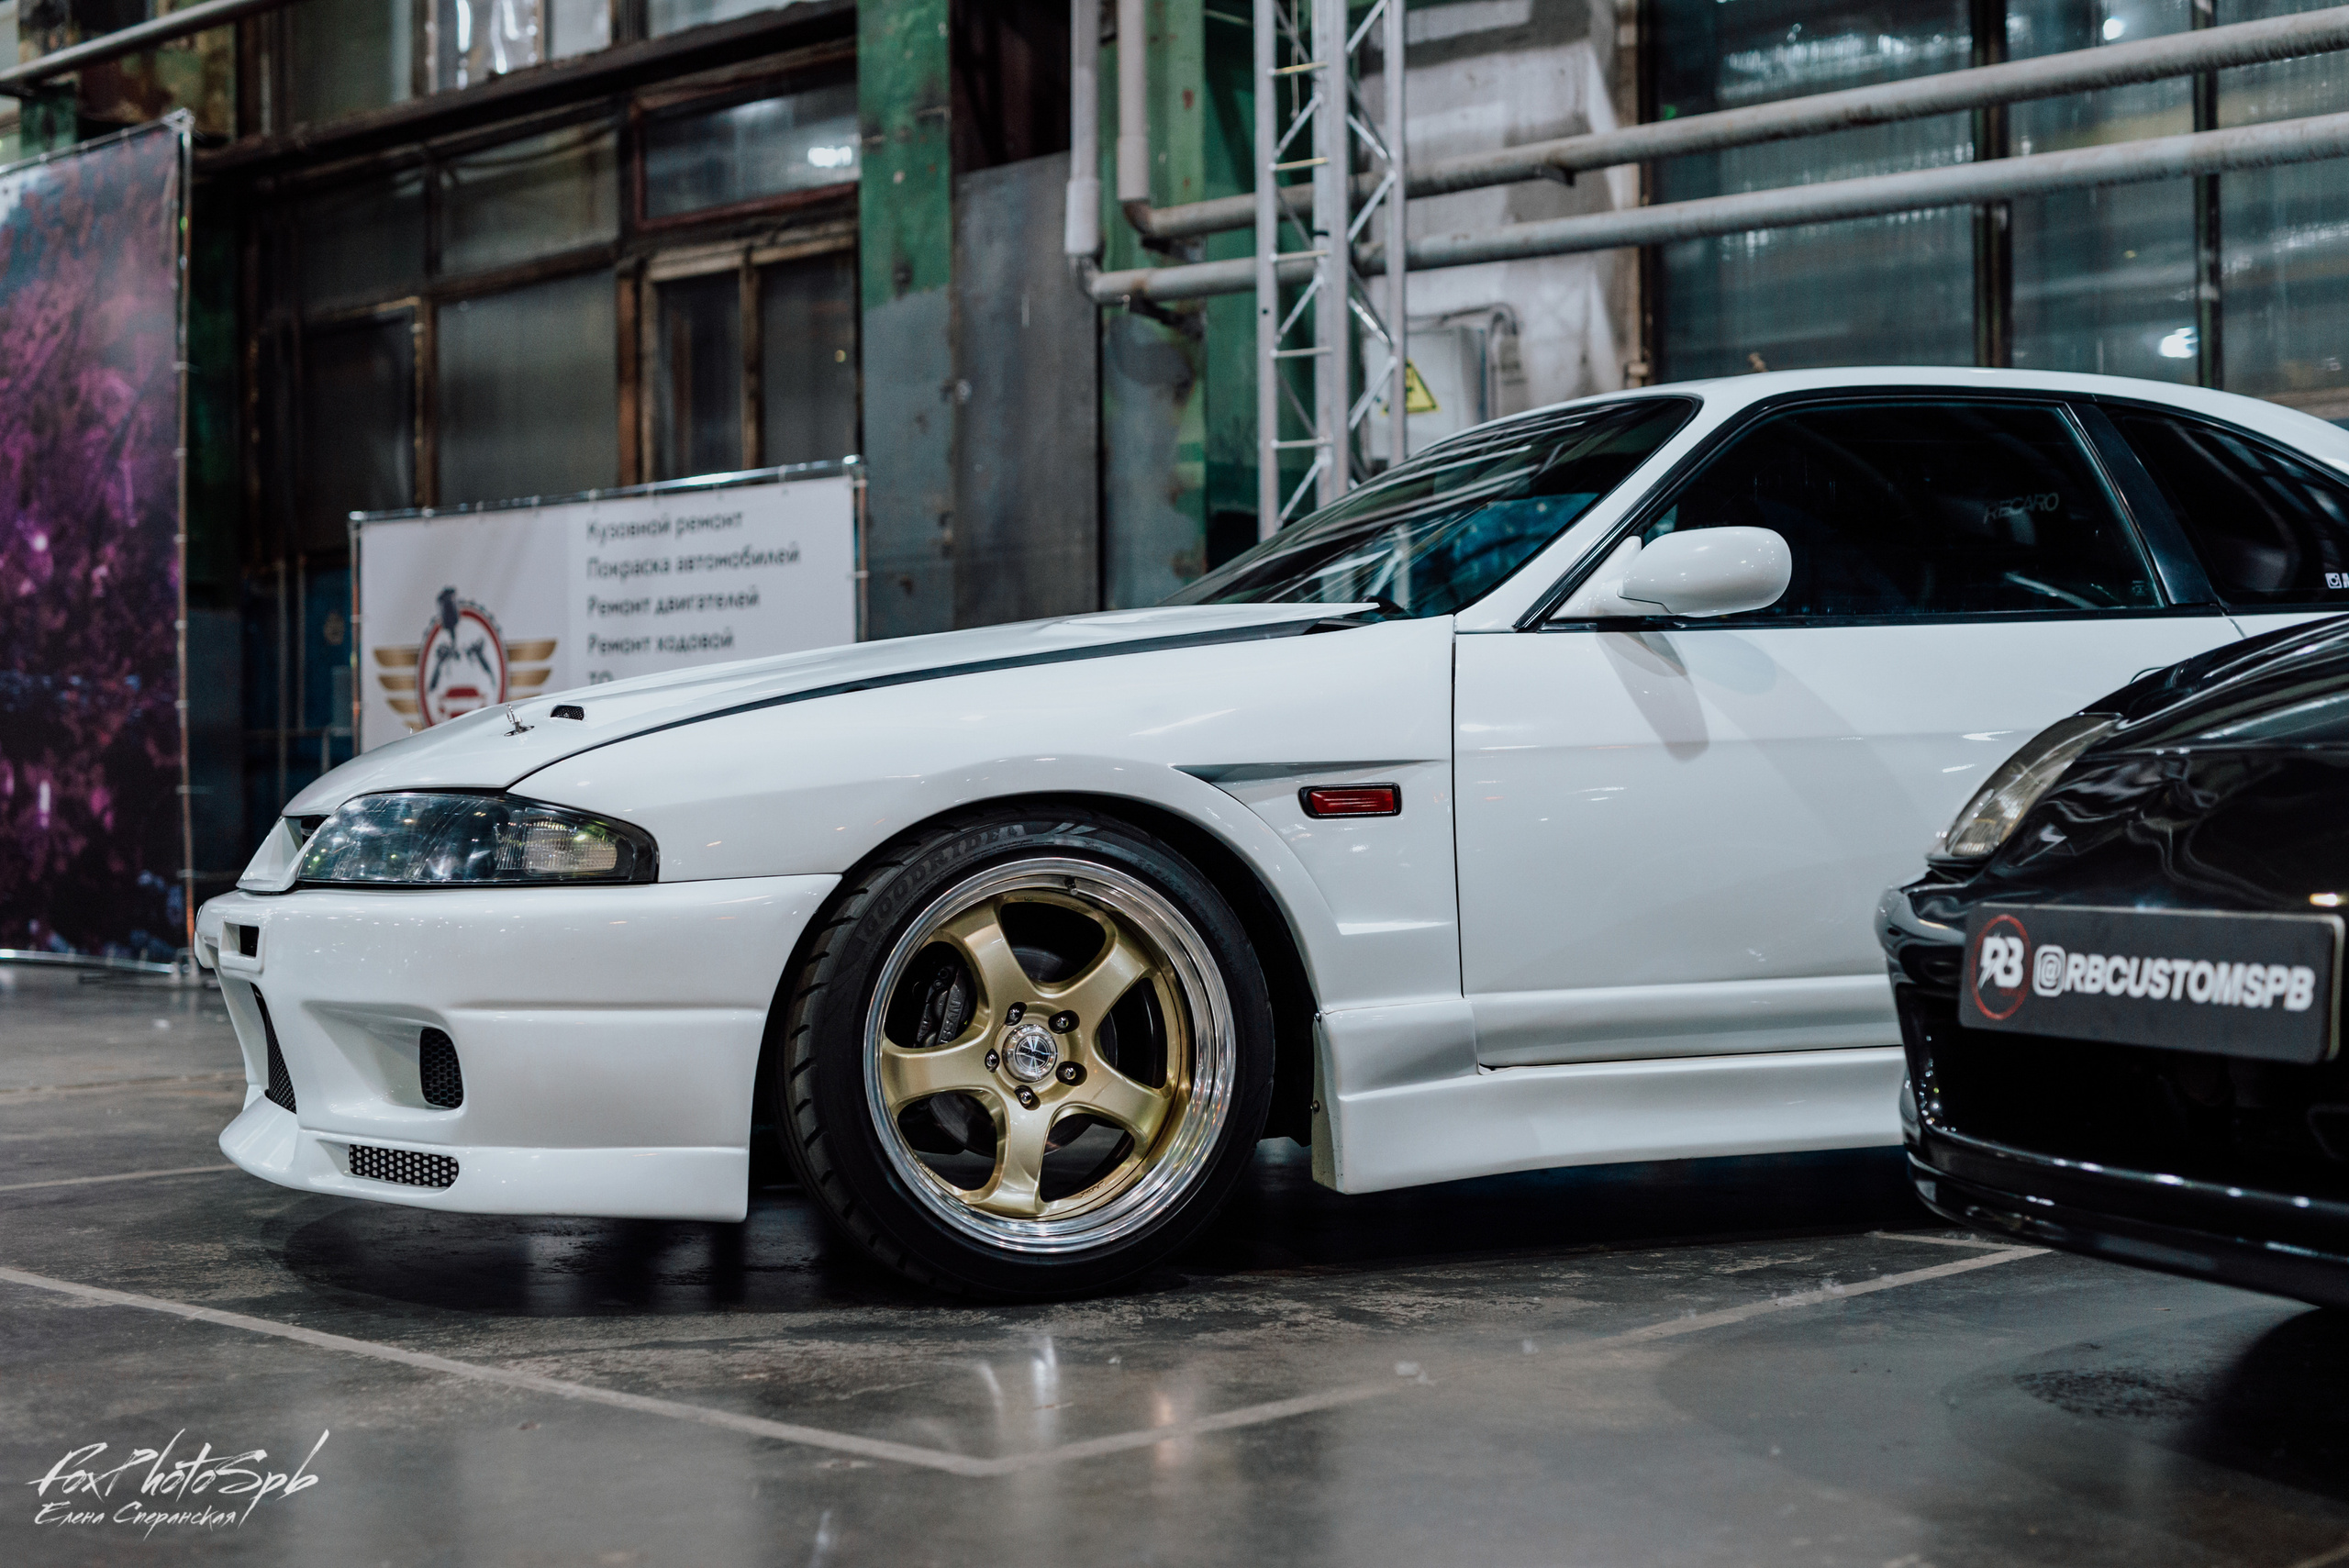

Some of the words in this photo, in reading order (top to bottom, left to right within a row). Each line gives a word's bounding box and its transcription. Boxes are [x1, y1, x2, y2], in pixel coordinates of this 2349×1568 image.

[1983, 493, 2059, 524] RECARO
[586, 513, 671, 545] Кузовной
[675, 511, 742, 539] ремонт
[586, 557, 670, 582] Покраска
[676, 541, 800, 573] автомобилей
[587, 595, 651, 617] Ремонт
[654, 584, 760, 616] двигателей
[587, 633, 651, 654] Ремонт
[655, 627, 733, 653] ходовой
[2032, 944, 2316, 1012] @RBCUSTOMSPB
